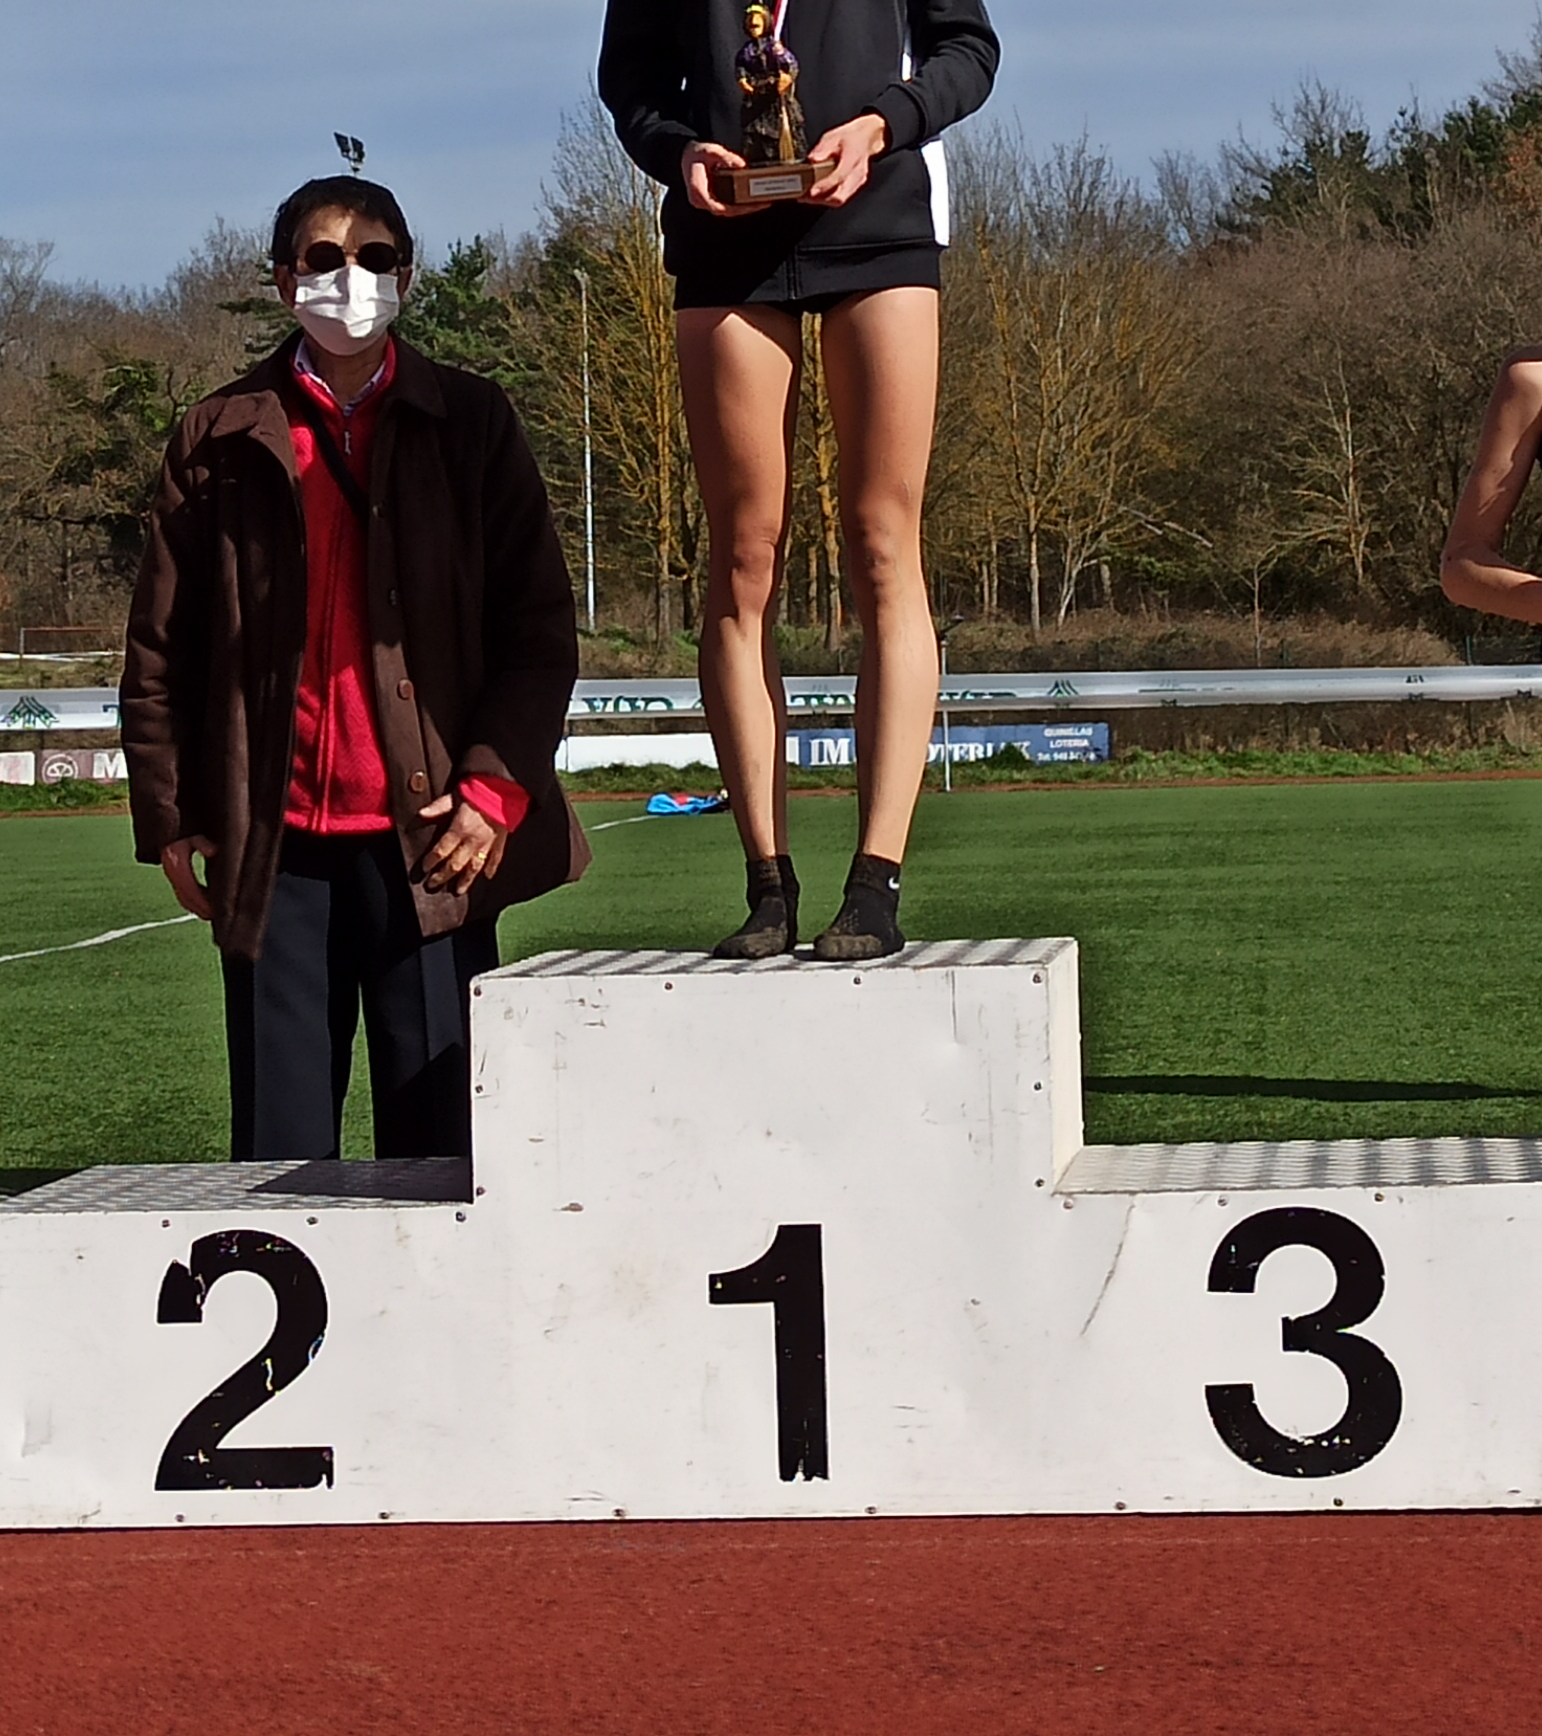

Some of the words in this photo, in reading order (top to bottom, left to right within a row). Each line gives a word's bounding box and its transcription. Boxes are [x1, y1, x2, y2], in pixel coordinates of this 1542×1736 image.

[155, 1229, 335, 1491] 2
[709, 1223, 828, 1482] 1
[1205, 1206, 1404, 1478] 3
